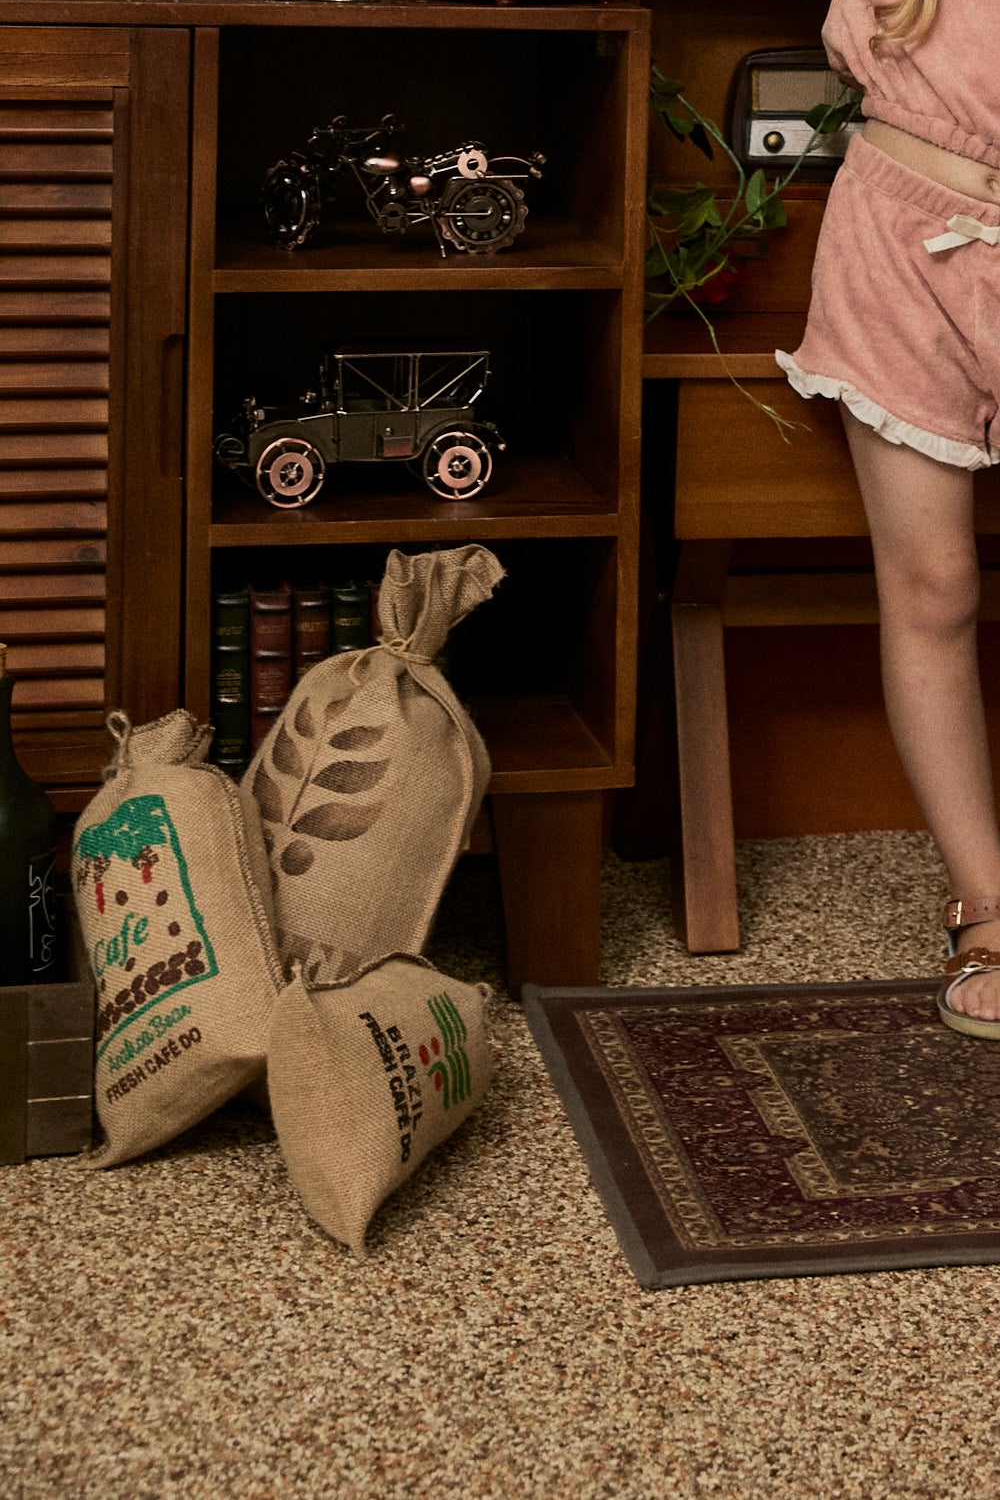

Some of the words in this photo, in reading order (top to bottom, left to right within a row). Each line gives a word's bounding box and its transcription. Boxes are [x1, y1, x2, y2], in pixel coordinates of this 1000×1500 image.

[106, 1065, 147, 1104] FRESH
[144, 1039, 181, 1074] CAFÉ
[178, 1027, 201, 1050] DO
[358, 1012, 398, 1073] FRESH
[400, 1133, 411, 1163] DO
[385, 1025, 423, 1131] BRAZIL
